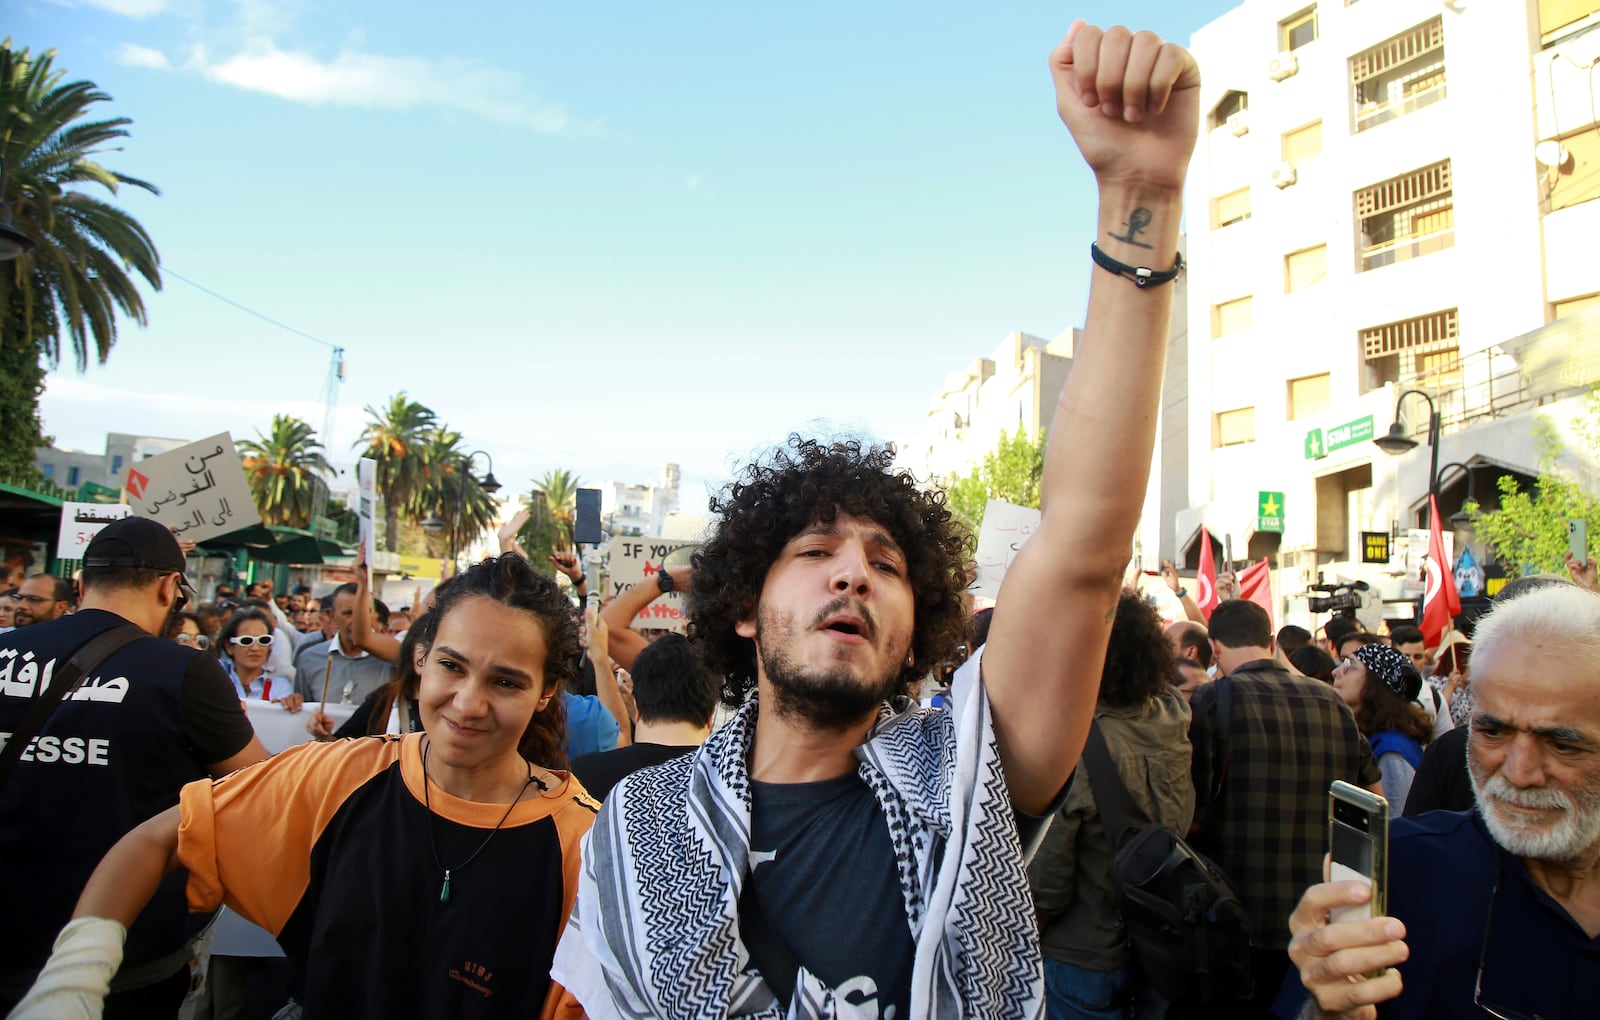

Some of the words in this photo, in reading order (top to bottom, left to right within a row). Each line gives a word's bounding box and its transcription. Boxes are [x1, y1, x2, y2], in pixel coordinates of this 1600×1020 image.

[185, 445, 224, 474] من
[147, 469, 216, 515] الفوضى
[212, 497, 232, 526] إلى
[622, 543, 643, 559] IF
[1367, 546, 1387, 560] ONE
